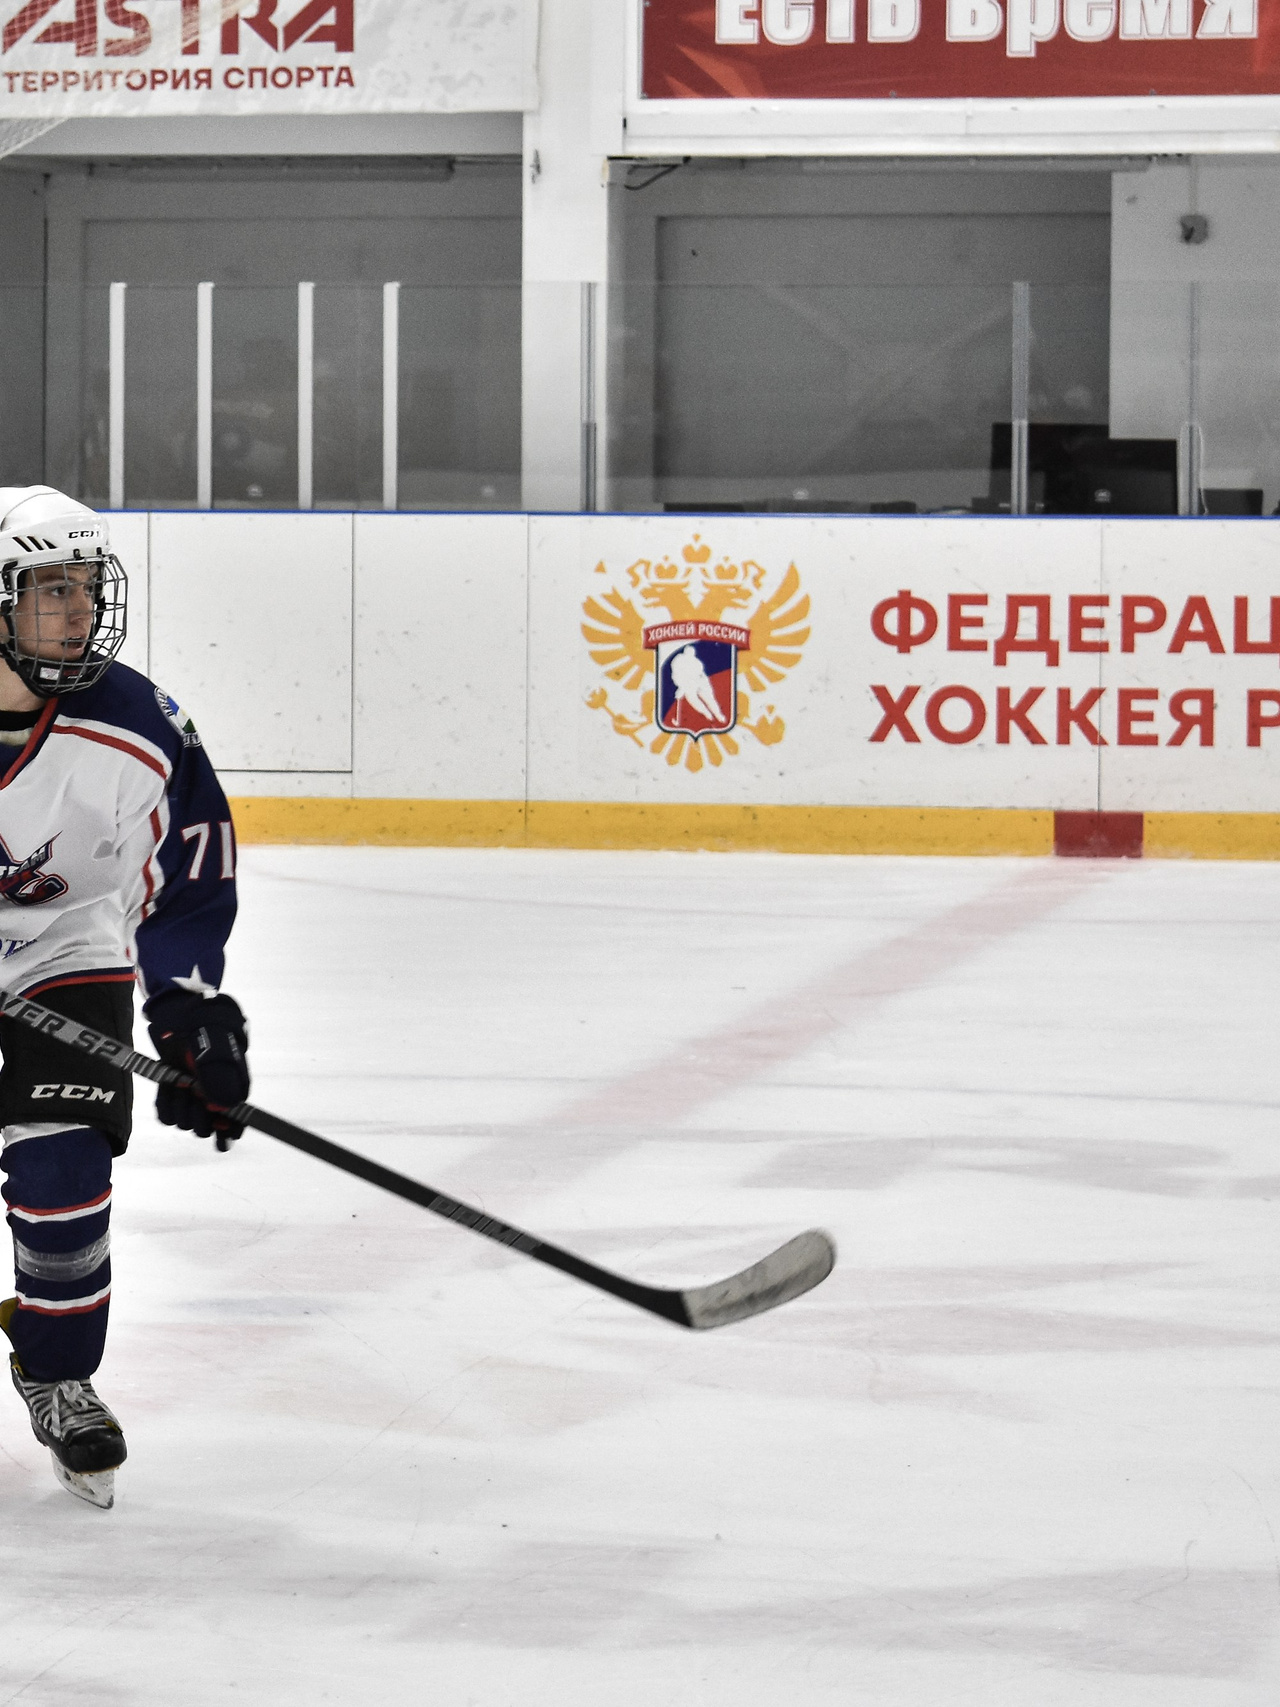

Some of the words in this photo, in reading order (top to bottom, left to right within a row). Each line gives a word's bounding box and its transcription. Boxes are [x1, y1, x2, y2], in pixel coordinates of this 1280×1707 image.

[2, 68, 212, 93] ТЕРРИТОРИЯ
[223, 66, 355, 89] СПОРТА
[648, 622, 695, 641] ХОККЕЙ
[698, 623, 746, 642] РОССИИ
[870, 590, 1280, 667] ФЕДЕРАЦ
[867, 685, 1216, 747] ХОККЕЯ
[182, 821, 234, 879] 71
[31, 1084, 116, 1104] CCM
